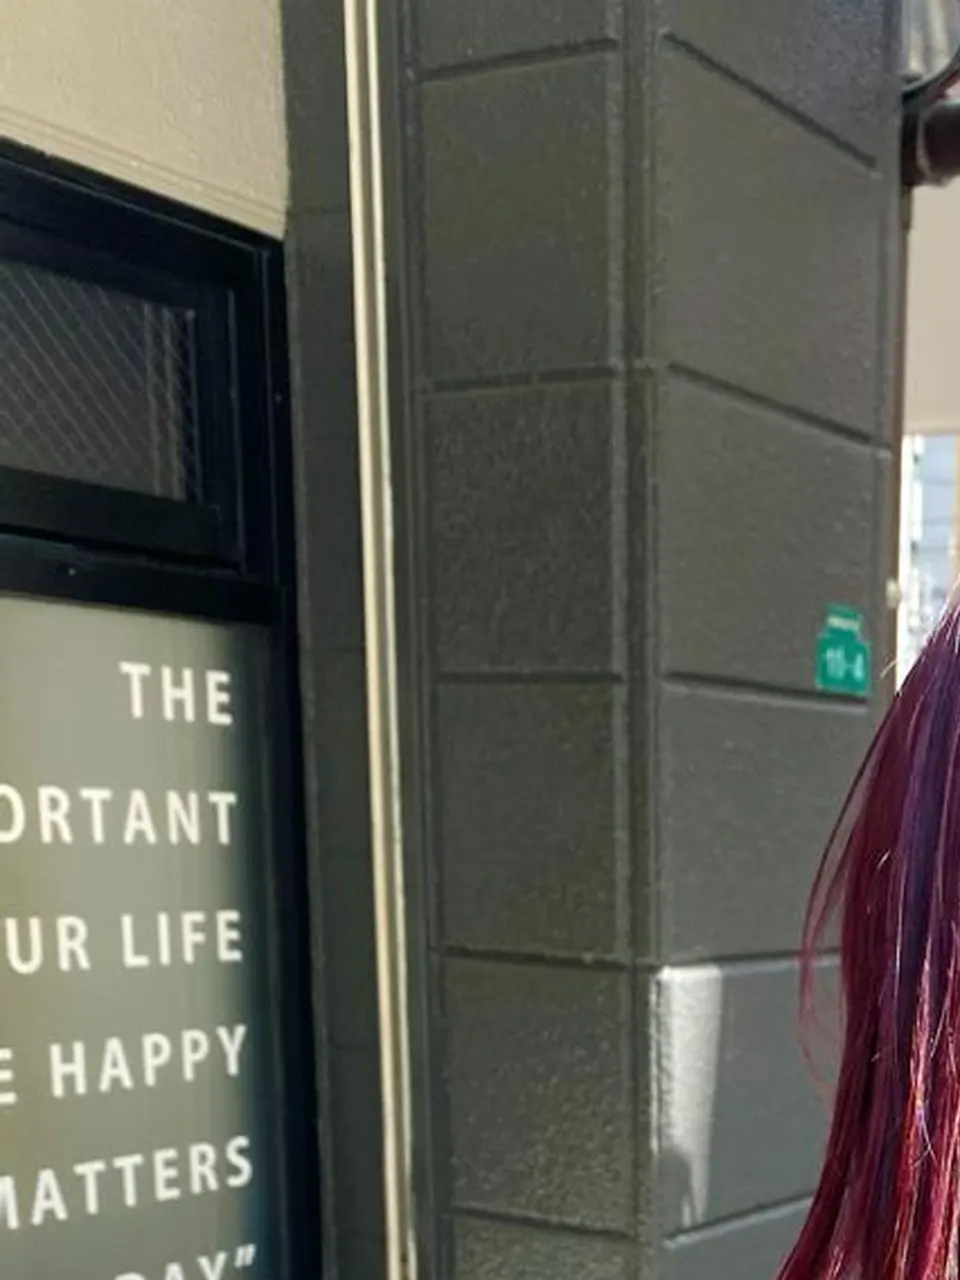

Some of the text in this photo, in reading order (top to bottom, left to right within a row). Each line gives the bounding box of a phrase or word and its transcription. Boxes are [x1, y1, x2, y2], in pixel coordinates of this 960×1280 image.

[119, 661, 234, 725] THE
[0, 783, 238, 845] ORTANT
[4, 909, 244, 974] UR LIFE
[49, 1023, 248, 1098] HAPPY
